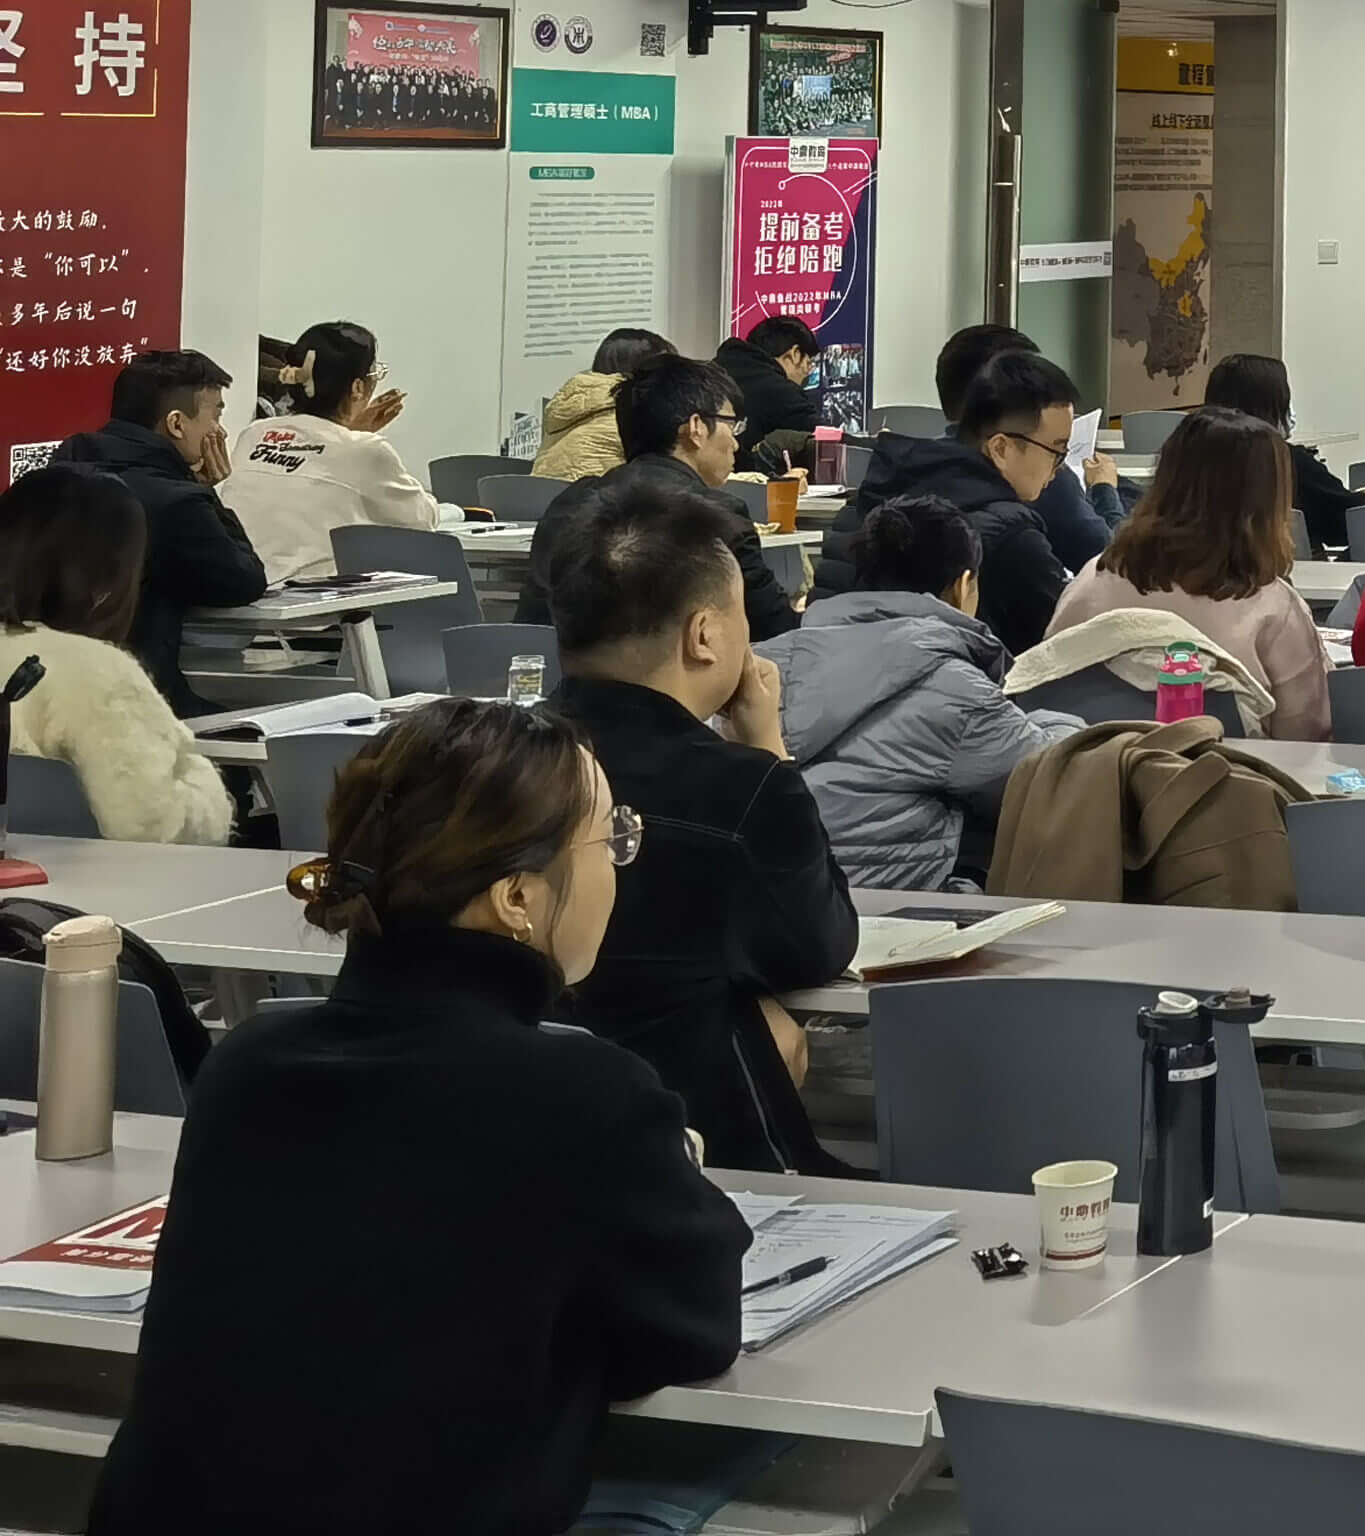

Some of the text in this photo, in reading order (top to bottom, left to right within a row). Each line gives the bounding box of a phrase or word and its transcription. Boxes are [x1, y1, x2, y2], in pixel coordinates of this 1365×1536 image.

[760, 211, 845, 242] 提前备考
[754, 245, 843, 276] 拒绝陪跑
[0, 298, 137, 325] 多年后说一句
